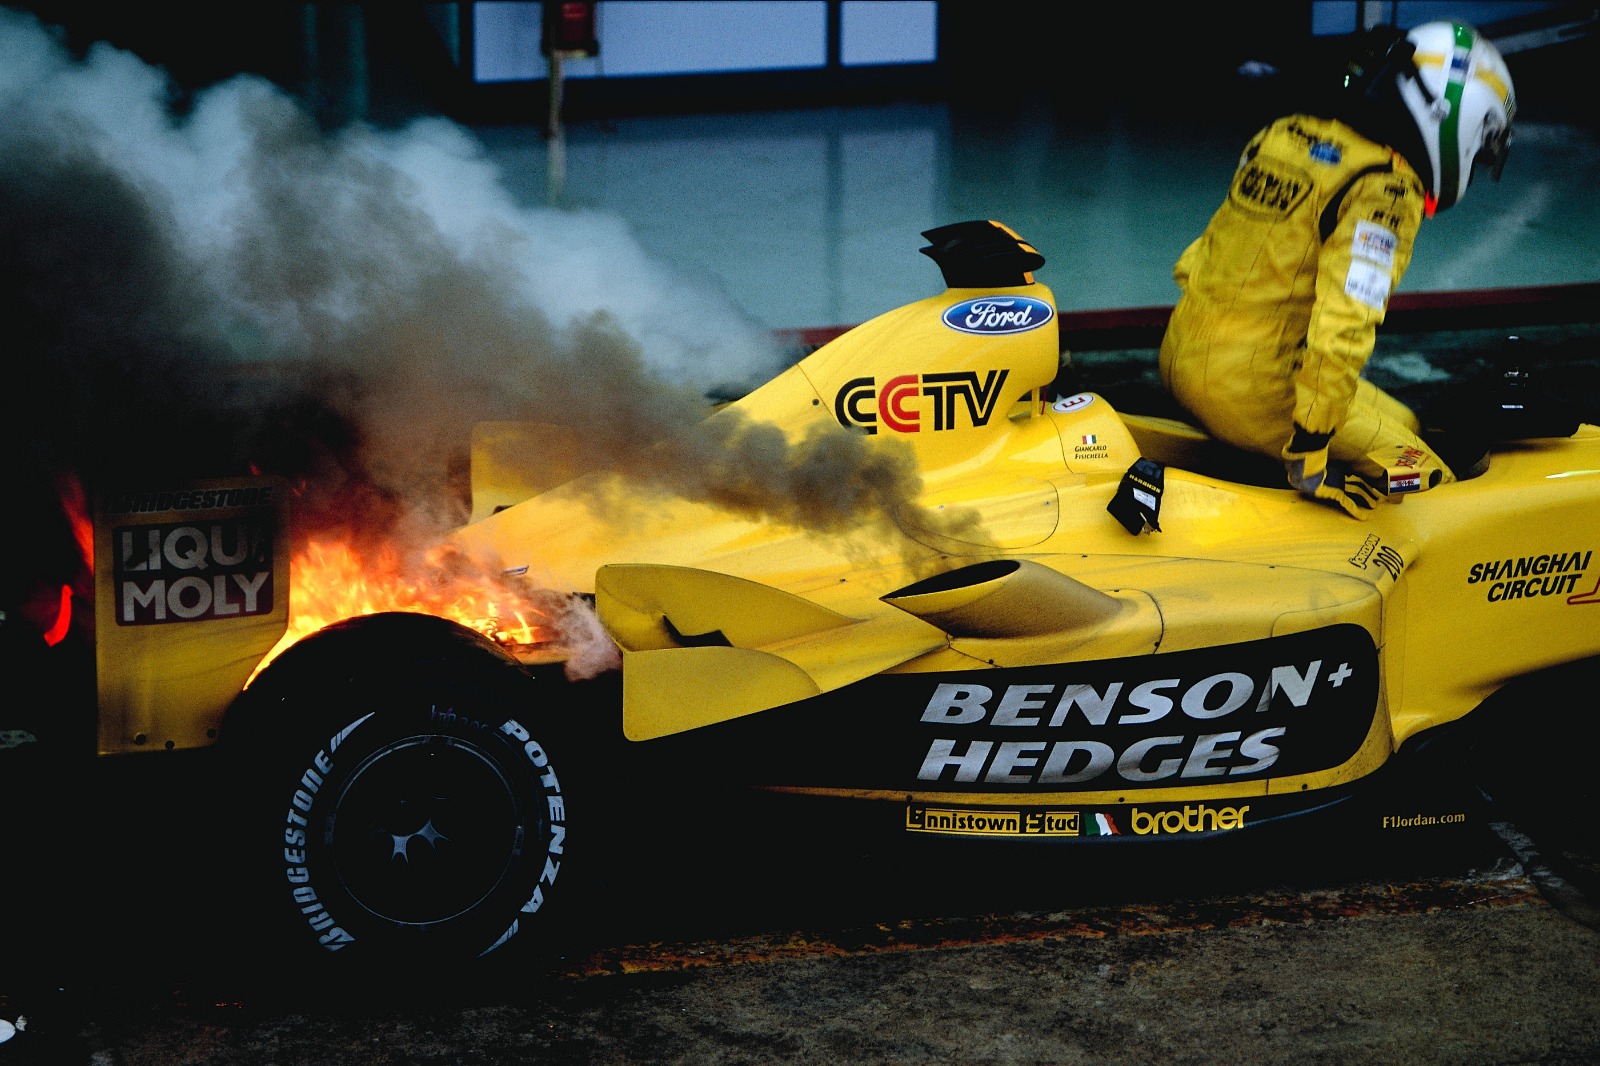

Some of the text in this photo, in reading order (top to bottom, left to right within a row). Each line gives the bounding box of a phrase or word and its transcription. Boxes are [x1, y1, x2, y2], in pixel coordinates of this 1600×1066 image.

[965, 299, 1033, 329] Ford
[835, 369, 1010, 434] CCTV
[108, 487, 272, 514] BRIDGESTONE
[1373, 546, 1404, 582] 200
[1468, 550, 1593, 584] SHANGHAI
[123, 571, 270, 621] MOLY
[1488, 573, 1583, 602] CIRCUIT
[916, 726, 1287, 785] HEDGES
[499, 719, 567, 914] POTENZA
[1131, 805, 1249, 835] brother
[1382, 813, 1466, 829] F1Jordan.com
[284, 749, 356, 952] BRIDGESTONE
